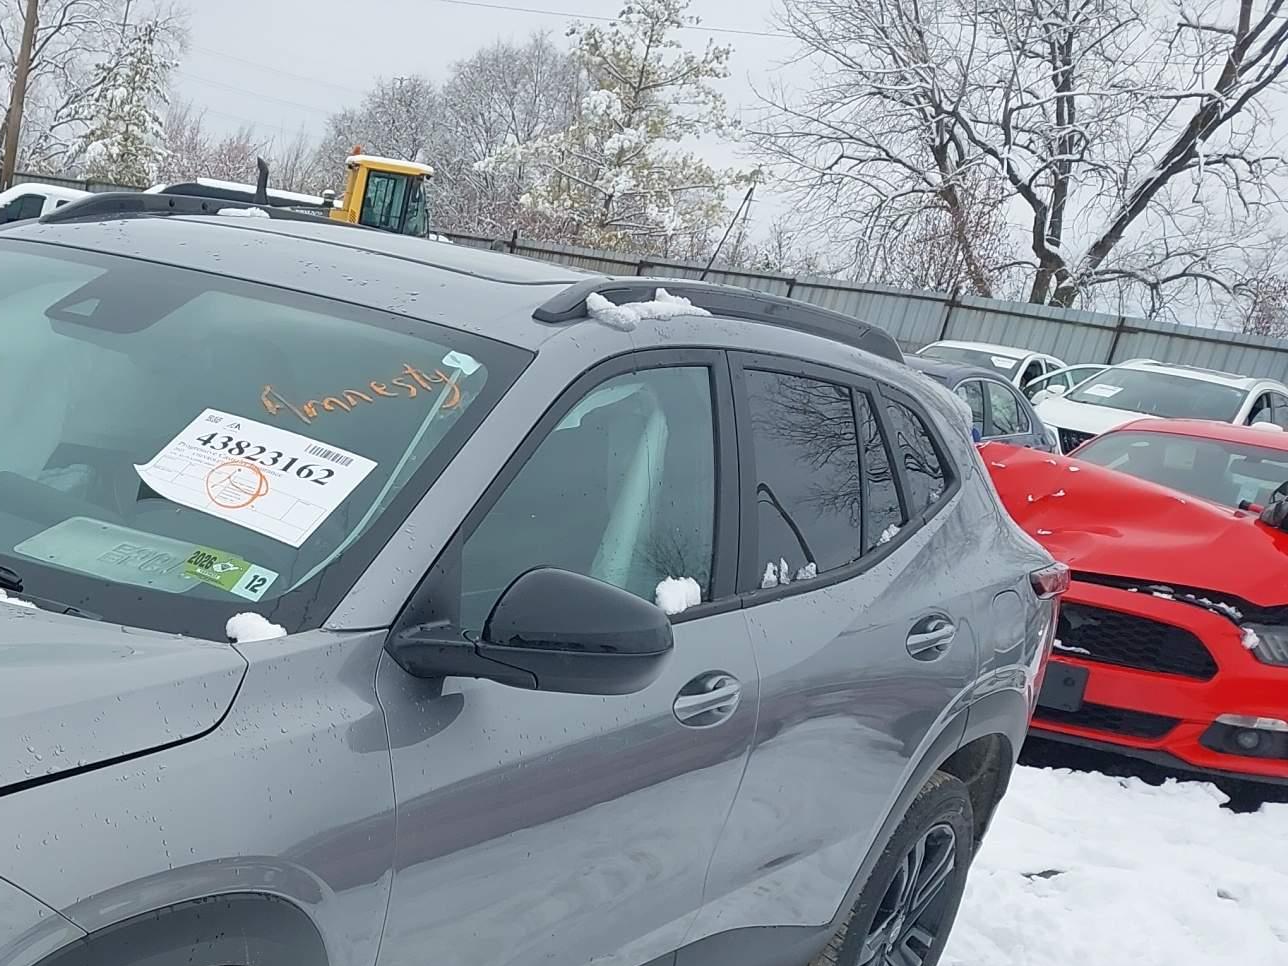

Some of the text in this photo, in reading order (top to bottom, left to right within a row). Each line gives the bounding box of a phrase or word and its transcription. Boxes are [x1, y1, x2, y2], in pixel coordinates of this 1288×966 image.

[195, 431, 335, 486] 43823162
[187, 550, 218, 570] 2026
[244, 574, 268, 594] 12
